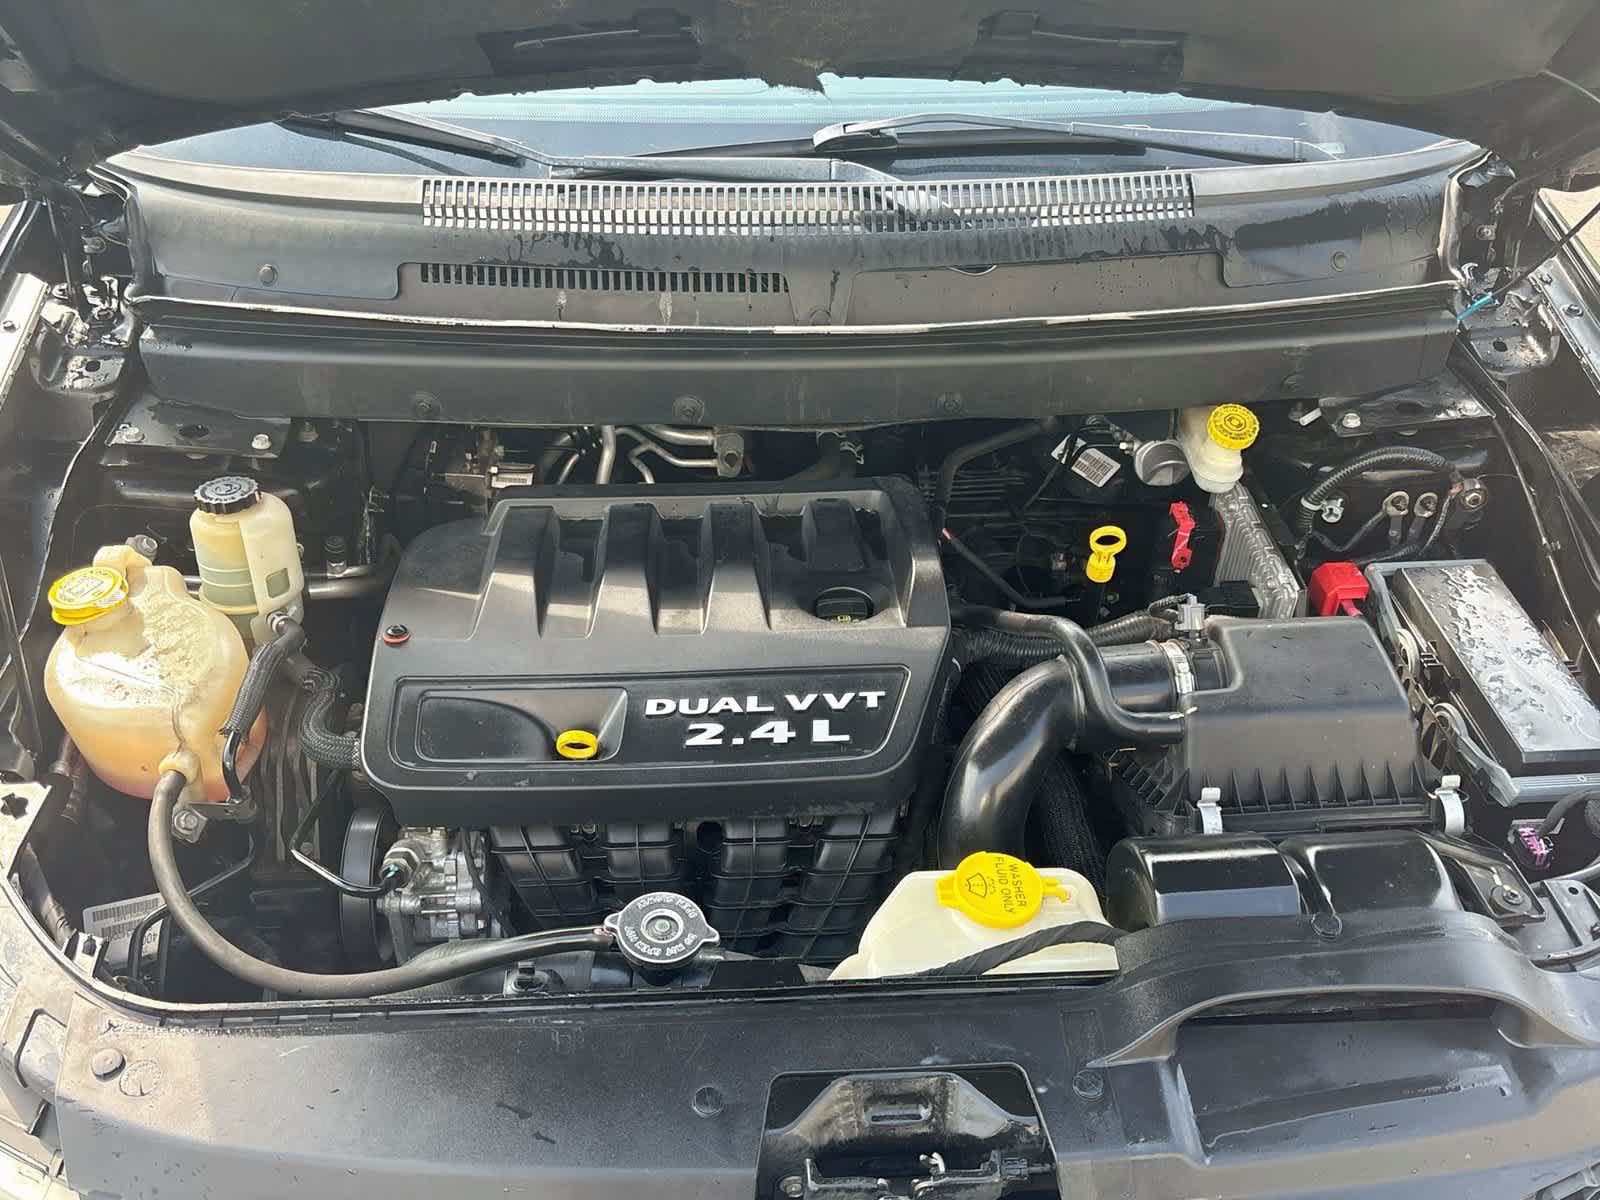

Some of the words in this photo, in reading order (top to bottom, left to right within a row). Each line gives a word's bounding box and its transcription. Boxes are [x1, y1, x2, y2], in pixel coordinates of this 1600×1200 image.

[645, 695, 774, 716] DUAL
[784, 691, 886, 711] VVT
[684, 720, 796, 747] 2.4
[812, 719, 850, 743] L
[993, 856, 1009, 885] FLUID
[1008, 863, 1028, 907] WASHER
[1000, 888, 1017, 914] ONLY
